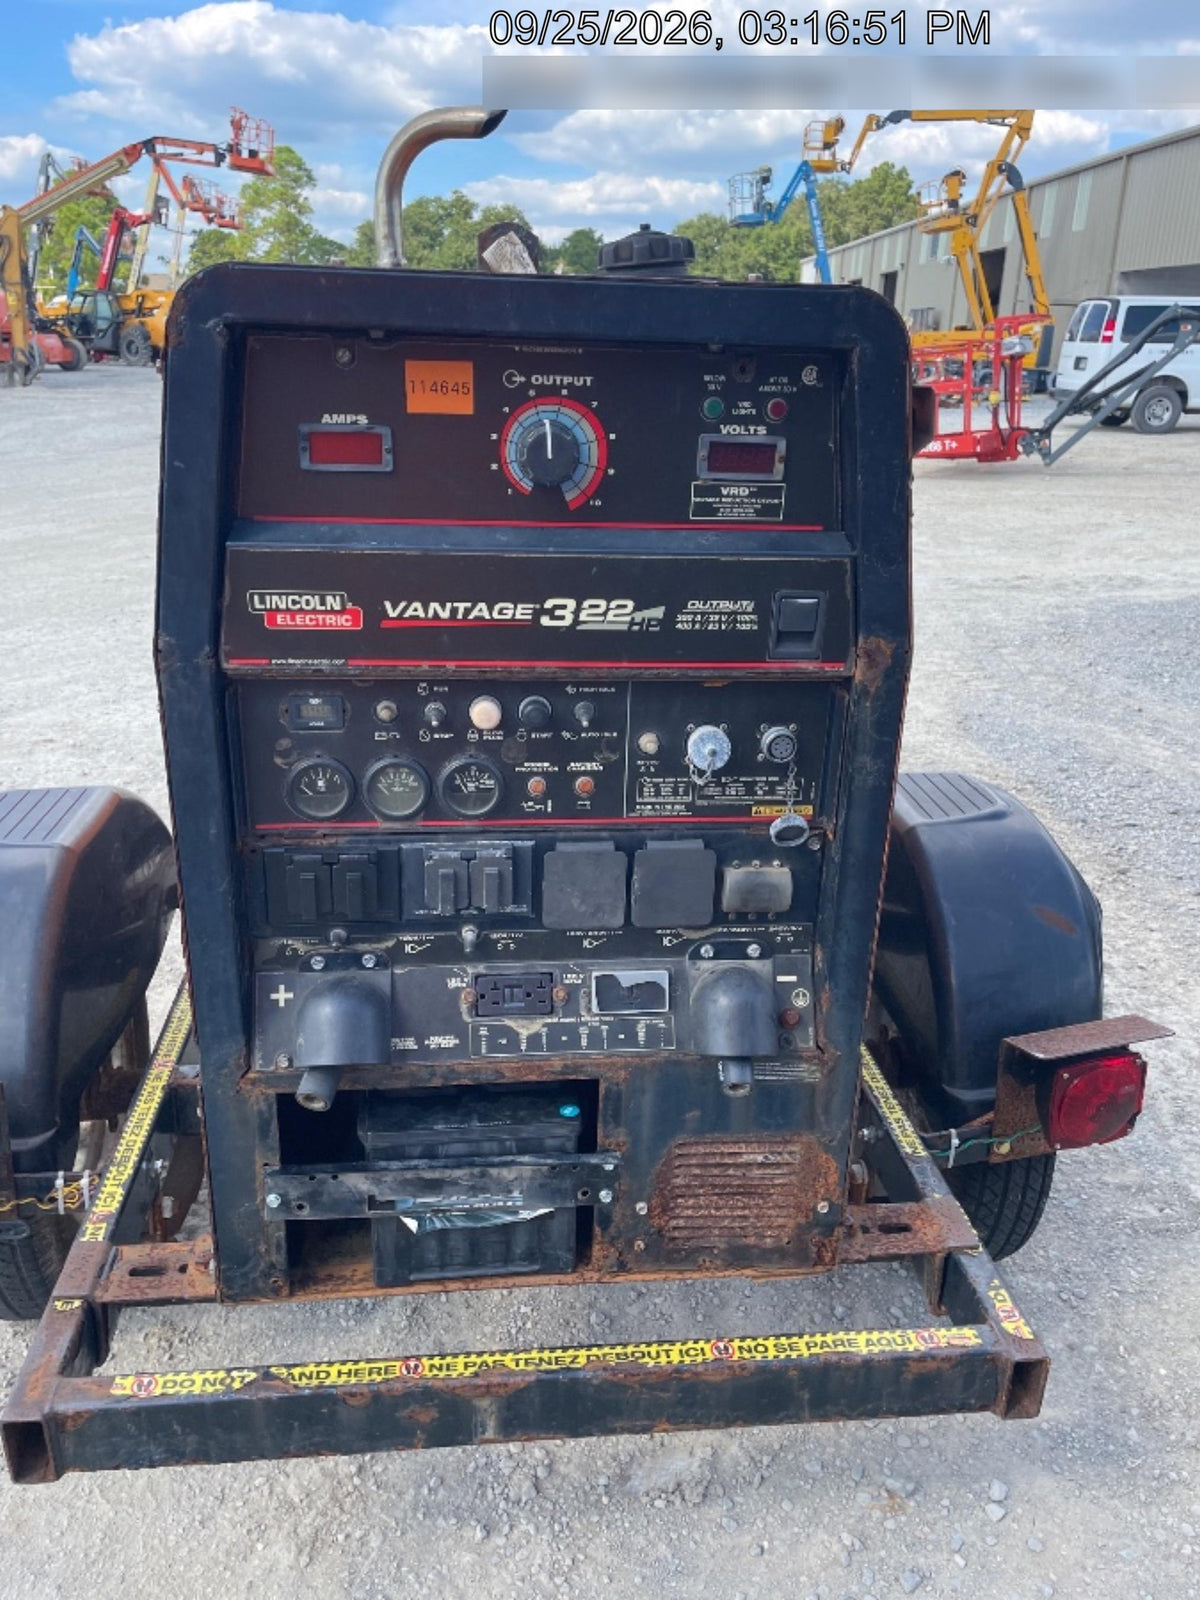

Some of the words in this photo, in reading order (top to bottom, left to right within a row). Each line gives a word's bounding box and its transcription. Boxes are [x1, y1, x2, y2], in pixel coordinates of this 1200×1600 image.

[409, 379, 471, 396] 114645
[530, 374, 594, 387] OUTPUT
[321, 413, 369, 425] AMPS
[720, 424, 767, 435] VOLTS
[253, 594, 342, 611] LINCOLN
[686, 600, 751, 611] OUTPUT
[384, 600, 534, 620] VANTAGE
[540, 598, 635, 627] 322
[276, 614, 353, 627] ELECTRIC
[738, 1343, 769, 1355] NO
[773, 1342, 800, 1352] SE
[805, 1338, 859, 1351] PARE
[430, 1362, 457, 1373] NE
[513, 1356, 580, 1369] TENEZ
[679, 1346, 707, 1359] ICI
[337, 1365, 397, 1379] HERE
